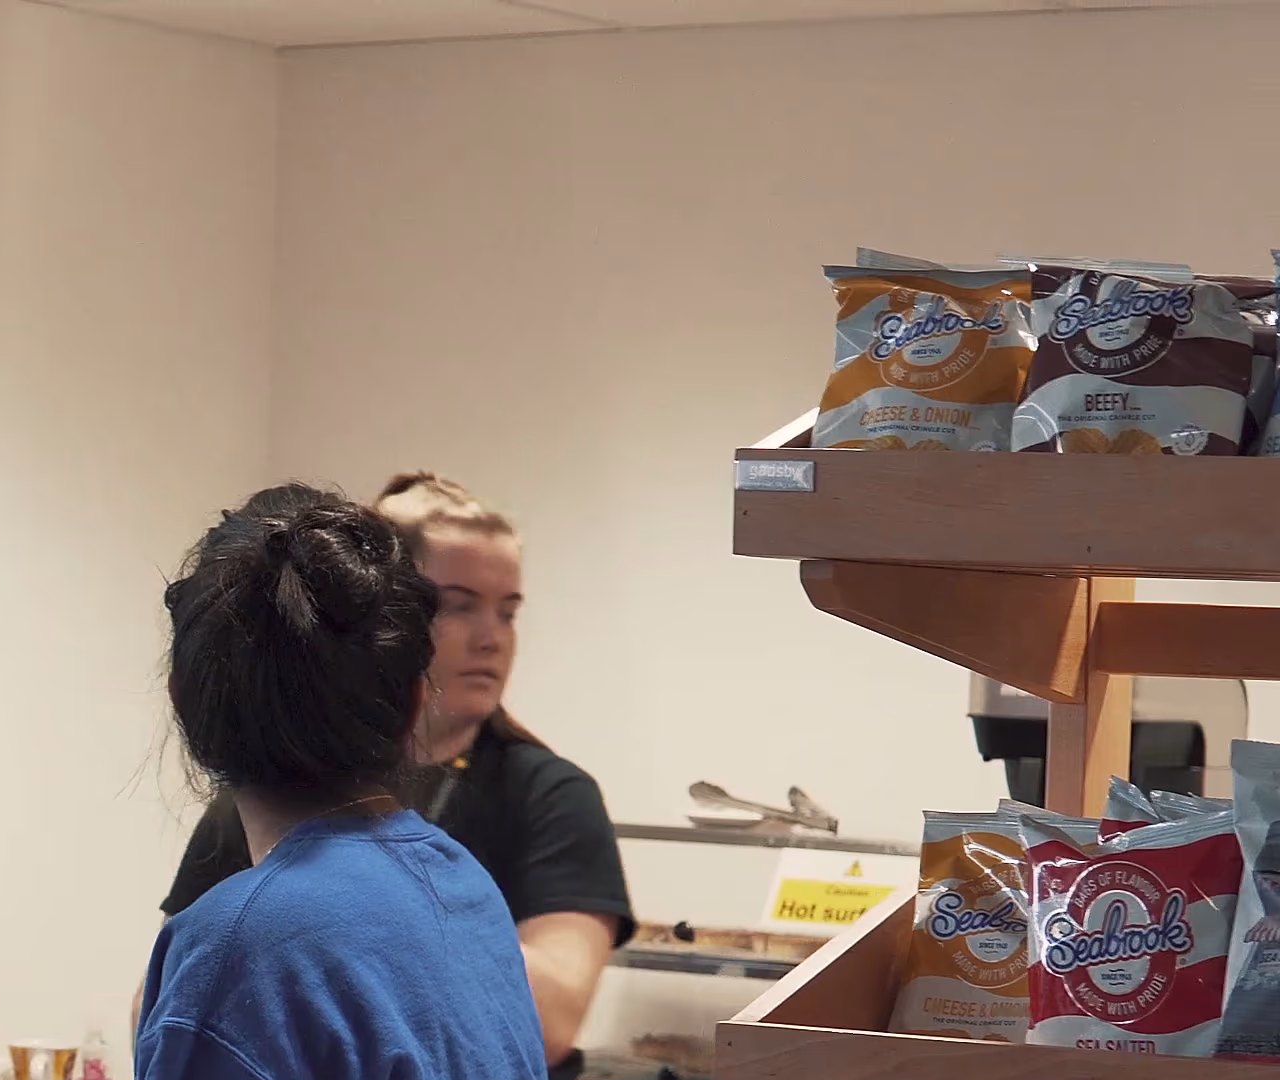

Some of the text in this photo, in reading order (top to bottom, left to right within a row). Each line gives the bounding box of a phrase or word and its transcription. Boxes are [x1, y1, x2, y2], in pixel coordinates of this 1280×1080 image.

[1054, 282, 1193, 338] Seabrook
[873, 295, 1003, 358] Seabrook
[943, 347, 976, 378] PRIDE
[1133, 335, 1163, 361] PRIDE
[858, 406, 972, 427] CHEESE & ONION
[1085, 392, 1130, 412] BEEFY
[1074, 879, 1097, 908] BAGS
[1098, 871, 1112, 886] OF
[1115, 870, 1161, 904] FLAVOUR
[778, 900, 816, 919] Hot
[1044, 894, 1189, 972] Seabrook
[952, 951, 977, 977] MADE
[980, 967, 1007, 982] WITH
[923, 997, 977, 1017] CHEESE
[1074, 973, 1167, 1016] MADE WITH PRIDE
